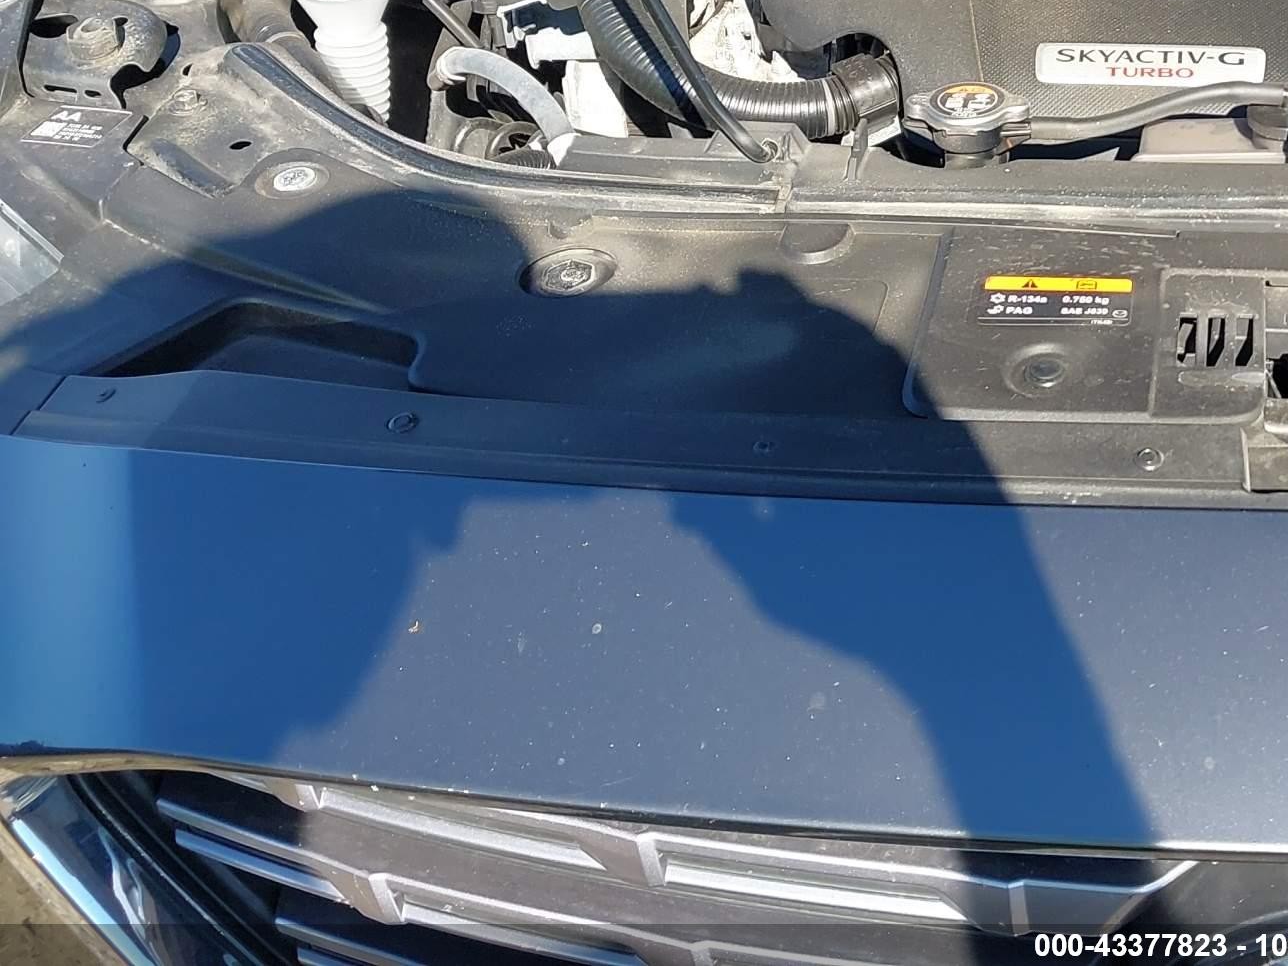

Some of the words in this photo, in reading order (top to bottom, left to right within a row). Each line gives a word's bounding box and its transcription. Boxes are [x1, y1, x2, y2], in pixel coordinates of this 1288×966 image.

[1055, 48, 1246, 66] SKYACTIV-G
[1107, 67, 1195, 78] TURBO
[1007, 294, 1048, 304] R-134a
